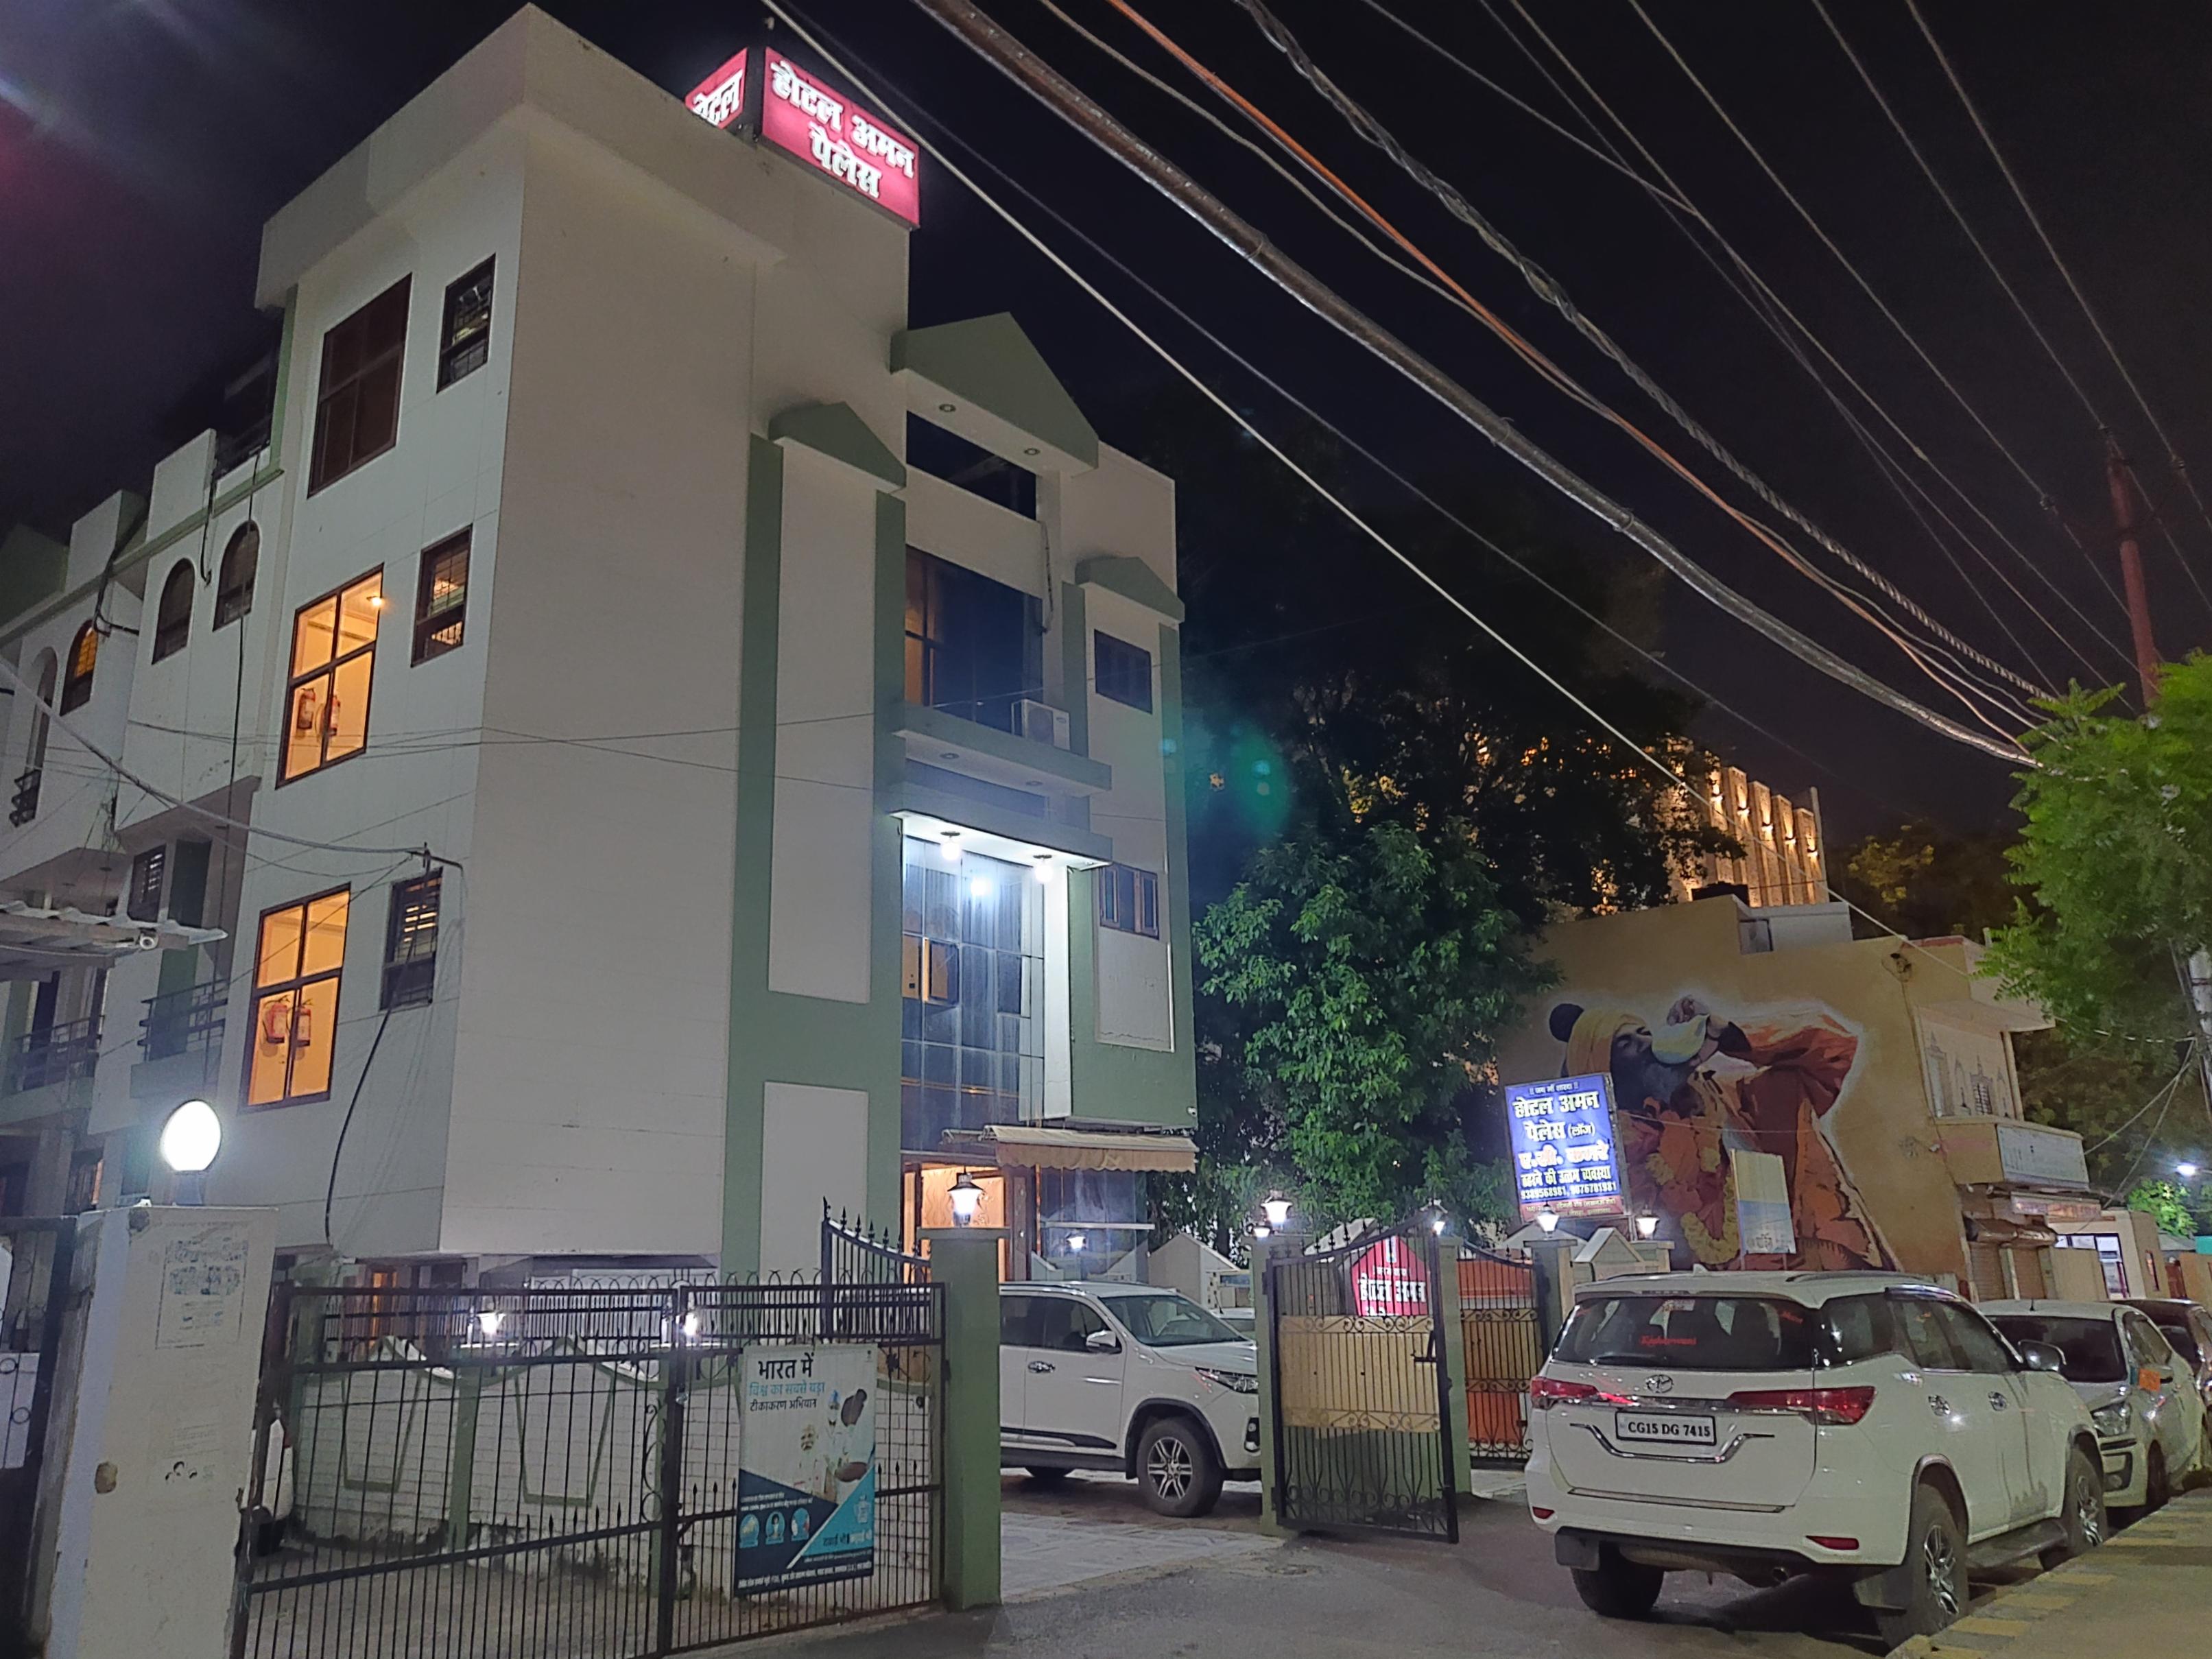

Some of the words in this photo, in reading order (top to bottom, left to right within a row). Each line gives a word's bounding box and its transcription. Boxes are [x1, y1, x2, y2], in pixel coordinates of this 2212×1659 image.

[770, 60, 843, 133] होटल
[851, 115, 914, 178] अमन
[809, 121, 881, 198] पैलेस
[1512, 1096, 1554, 1118] होटल
[1558, 1090, 1600, 1112] अमन
[758, 1359, 797, 1380] भारत
[800, 1352, 815, 1378] में
[770, 1383, 783, 1395] का
[750, 1398, 787, 1412] टीकाकरण
[789, 1396, 818, 1409] अभियान
[1628, 1422, 1658, 1434] CG15
[1661, 1424, 1680, 1435] DG
[1683, 1424, 1711, 1437] 7415
